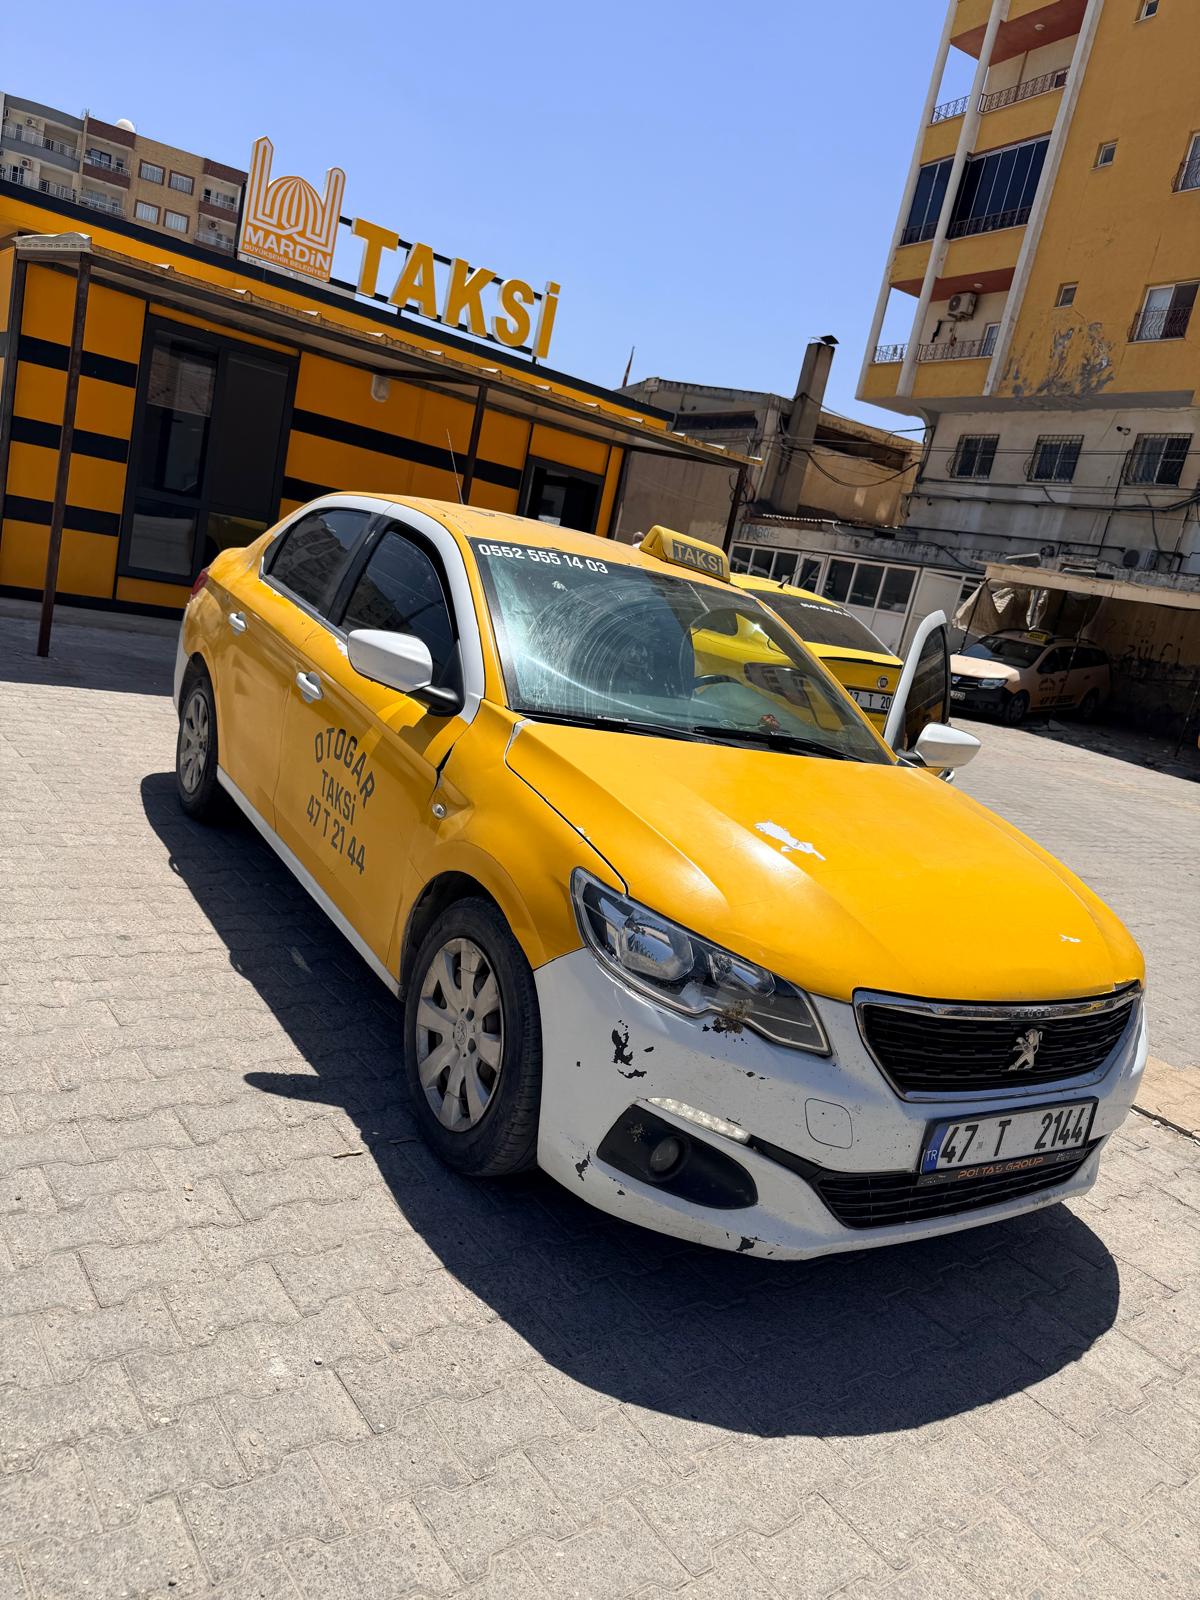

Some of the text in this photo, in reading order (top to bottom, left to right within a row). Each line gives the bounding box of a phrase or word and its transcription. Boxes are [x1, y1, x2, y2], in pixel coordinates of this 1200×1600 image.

[477, 543, 609, 574] 0552 555 14 03
[868, 693, 874, 707] T
[315, 727, 375, 809] OTOGAR
[306, 794, 366, 875] 47 T 21 44
[940, 1107, 1086, 1164] 47 T 2144
[925, 1149, 938, 1162] TR
[1005, 1156, 1044, 1171] GROUP
